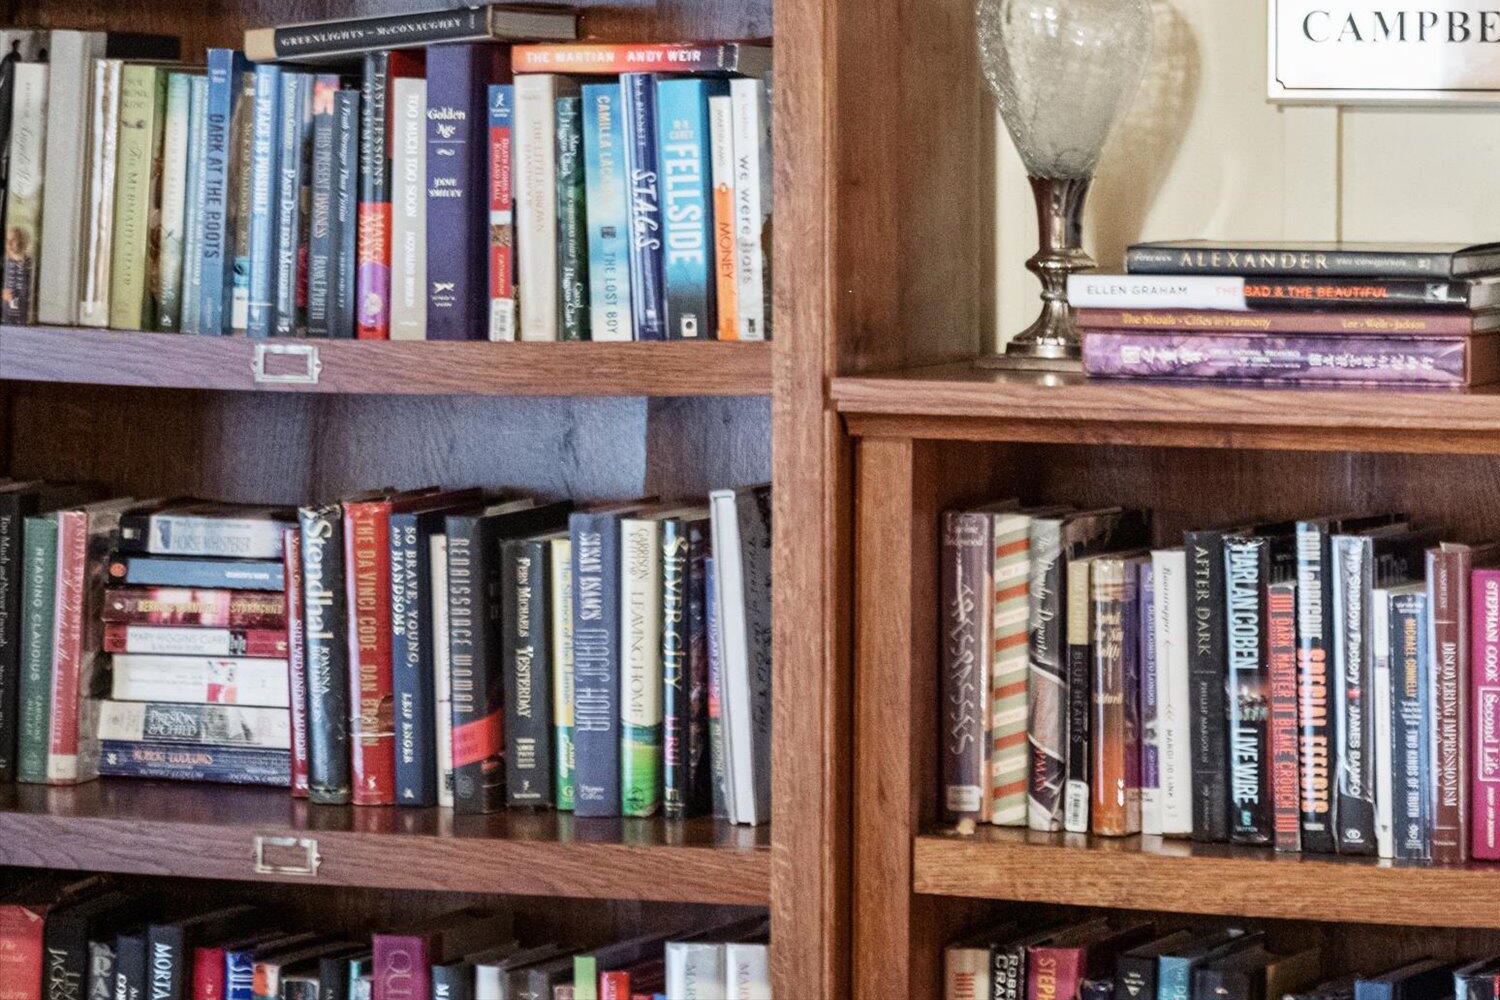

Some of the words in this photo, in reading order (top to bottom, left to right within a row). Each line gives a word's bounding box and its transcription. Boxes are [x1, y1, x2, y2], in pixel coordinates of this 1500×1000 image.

[526, 52, 549, 63] THE
[556, 52, 615, 63] MARTIAN
[627, 51, 662, 62] ANDY
[667, 50, 701, 62] WEIR
[362, 82, 372, 102] OF
[373, 72, 384, 109] LAST
[407, 94, 419, 118] TOO
[207, 114, 225, 152] DARK
[428, 109, 466, 120] Golden
[436, 122, 456, 138] Age
[597, 95, 612, 149] CAMILLA
[316, 127, 333, 148] THIS
[362, 119, 372, 176] SUMMER
[373, 116, 384, 186] LESSONS
[405, 120, 418, 154] MUCH
[560, 119, 570, 151] Higgins
[569, 135, 579, 156] Mary
[207, 157, 224, 173] AT
[282, 168, 296, 196] PAST
[315, 150, 331, 189] PRESENT
[405, 156, 417, 182] TOO
[561, 153, 572, 178] Clark
[738, 157, 748, 181] we
[206, 179, 223, 205] THE
[405, 185, 418, 217] SOON
[665, 143, 701, 265] FELLSIDE
[280, 200, 294, 225] DUE
[314, 192, 329, 238] DARKNESS
[739, 188, 751, 237] were
[204, 211, 222, 259] ROOTS
[280, 227, 291, 247] FOR
[719, 221, 733, 280] MONEY
[279, 250, 292, 298] MURDER
[604, 251, 615, 274] THE
[1180, 253, 1329, 270] ALEXANDER
[574, 283, 584, 309] Carol
[605, 278, 617, 309] LOST
[1087, 286, 1126, 295] ELLEN
[1131, 286, 1188, 295] GRAHAM
[1243, 285, 1271, 297] BAD
[1273, 286, 1286, 297] &
[1288, 286, 1313, 298] THE
[1315, 287, 1389, 298] BEAUTIFUL
[565, 299, 577, 329] Clark
[606, 311, 618, 334] BOY
[355, 521, 376, 542] THE
[393, 526, 401, 547] AND
[405, 526, 416, 543] SO
[357, 549, 376, 567] DA
[517, 558, 530, 585] FERN
[579, 532, 602, 573] SUSAN
[637, 528, 651, 581] GARRISON
[32, 548, 46, 607] READING
[305, 520, 334, 639] Stendhal
[357, 572, 377, 611] VINCI
[405, 549, 417, 604] BRAVE,
[449, 539, 472, 646] RENAISSANCE
[663, 534, 689, 623] SILVER
[1194, 545, 1210, 601] AFTER
[1230, 546, 1259, 613] HARLAN
[392, 550, 404, 636] HANDSOME
[517, 586, 530, 638] MICHAELS
[579, 576, 602, 621] ISAACS
[293, 619, 303, 668] SHELVED
[358, 618, 377, 652] CODE
[406, 610, 419, 668] YOUNG,
[630, 591, 644, 661] LEAVING
[1197, 607, 1211, 657] DARK
[1231, 616, 1260, 670] COBEN
[1276, 619, 1293, 648] DARK
[1404, 619, 1416, 658] MICHAEL
[30, 613, 43, 681] CLAUDIUS
[575, 628, 611, 682] MAGIC
[664, 630, 686, 691] CITY
[320, 646, 330, 694] JOANNA
[360, 664, 377, 693] DAN
[453, 654, 474, 713] WOMAN
[515, 646, 534, 719] YESTERDAY
[1278, 653, 1294, 698] MATTER
[1297, 648, 1326, 727] SPECIAL
[1405, 659, 1417, 699] CONNELLY
[1442, 642, 1456, 716] DISCOVERING
[293, 671, 304, 711] UNDER
[402, 693, 413, 719] LEIF
[575, 688, 611, 731] HOUR
[630, 666, 644, 719] HOME
[1200, 681, 1208, 714] PHILLIP
[361, 699, 379, 747] BROWN
[1483, 691, 1498, 742] Second
[294, 713, 306, 763] MURDER
[402, 723, 413, 763] ENGER
[1234, 727, 1258, 763] LIVE
[1278, 719, 1296, 754] BLAKE
[1406, 729, 1418, 748] TWO
[1301, 736, 1329, 814] EFFECTS
[1407, 750, 1419, 777] KINDS
[1443, 719, 1457, 807] IMPRESSIONISM
[1483, 746, 1500, 775] Life
[1234, 763, 1258, 804] WIRE
[1279, 760, 1297, 809] CROUCH
[1407, 779, 1419, 789] OF
[1407, 791, 1419, 818] TRUTH
